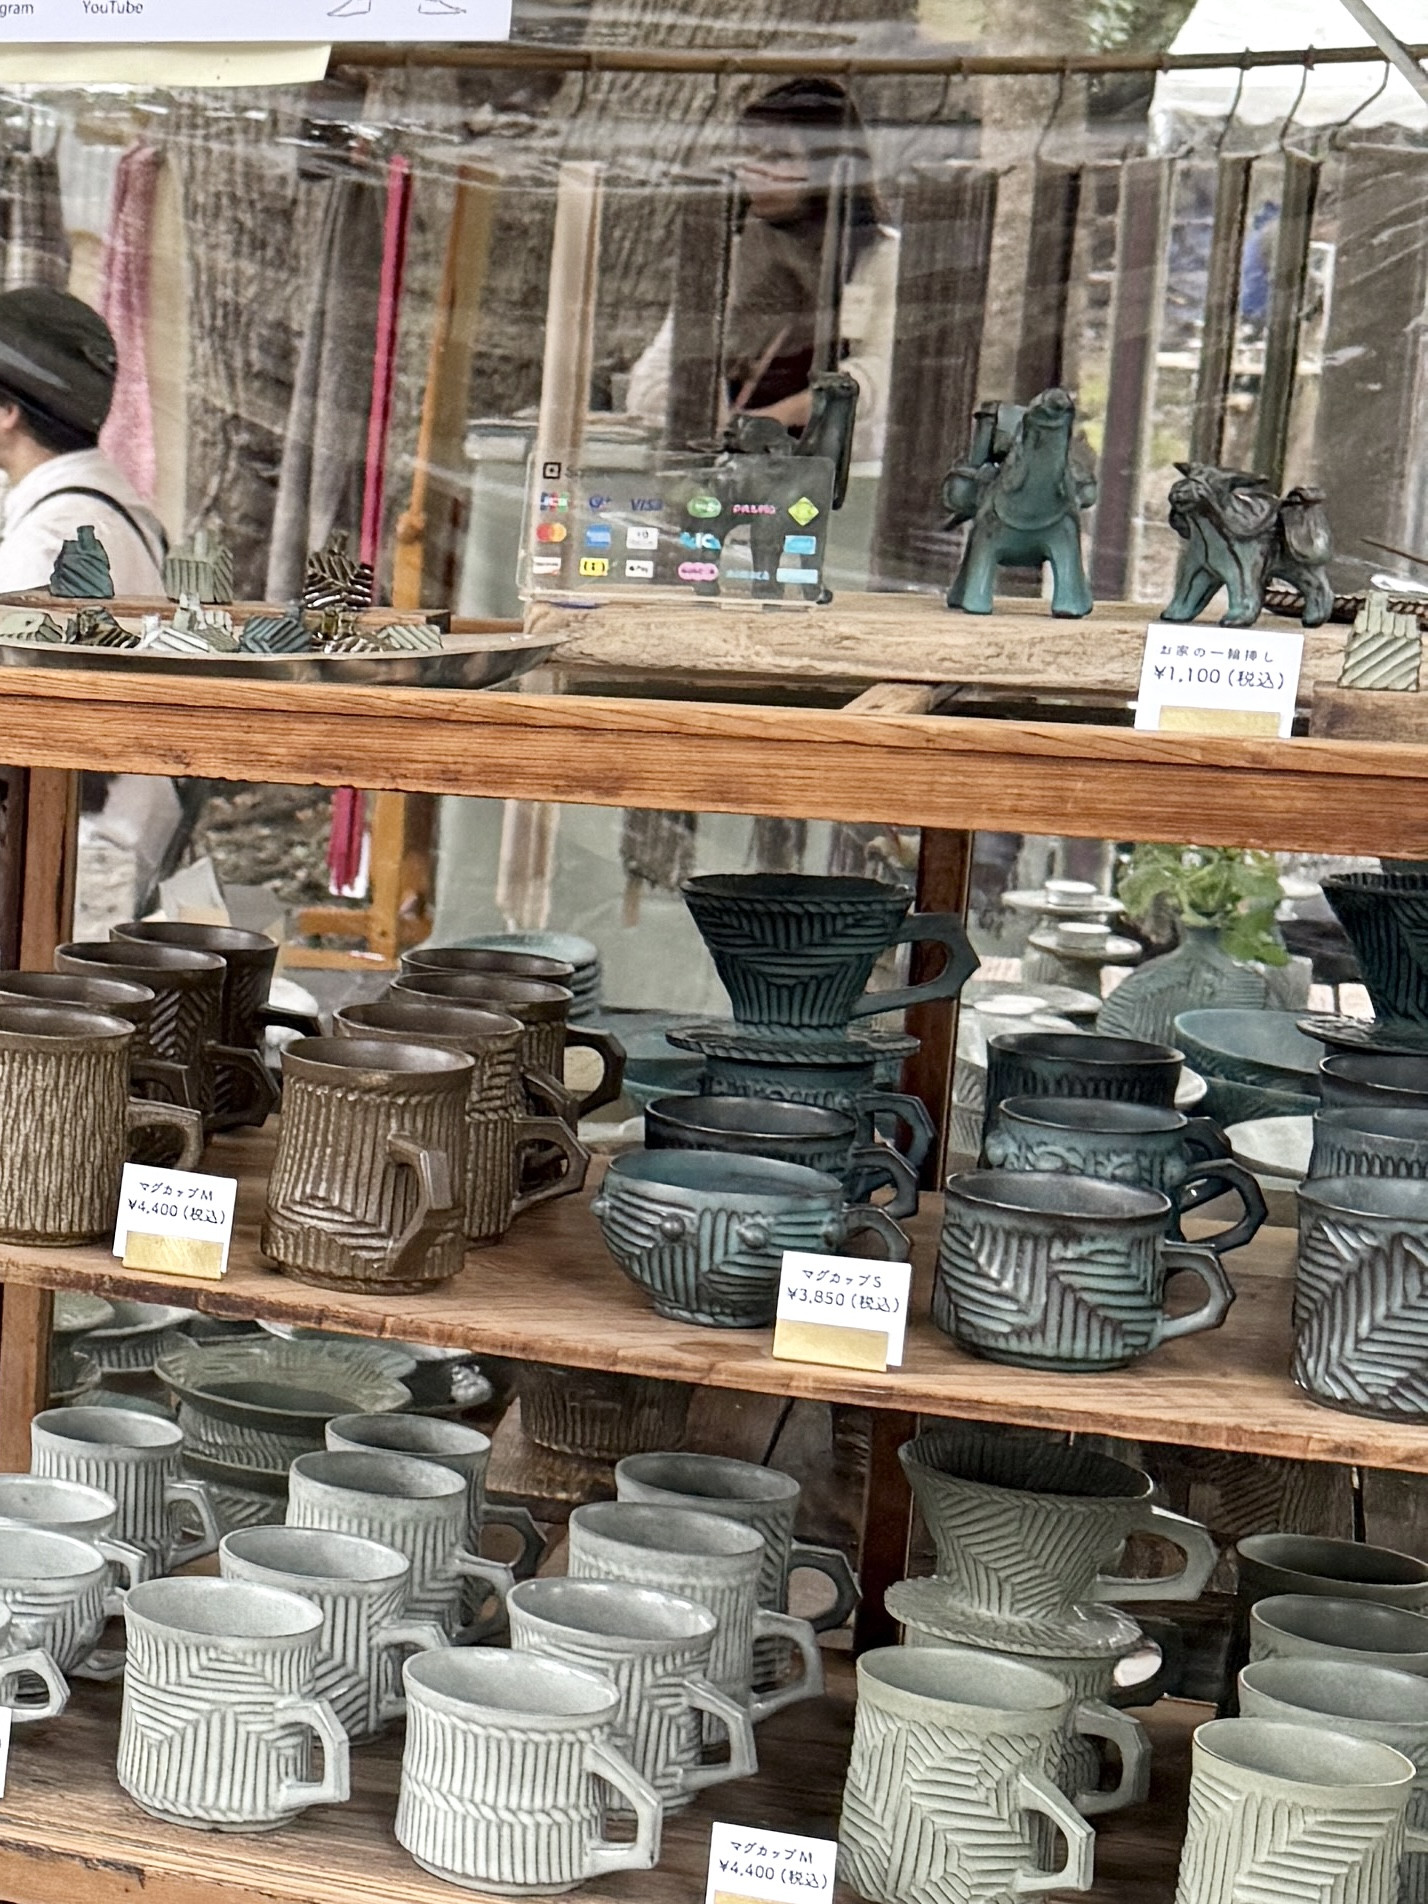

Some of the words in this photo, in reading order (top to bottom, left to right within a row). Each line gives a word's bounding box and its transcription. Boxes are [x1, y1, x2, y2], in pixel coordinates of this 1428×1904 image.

[82, 0, 143, 14] YouTube
[801, 1269, 882, 1289] マグカップS
